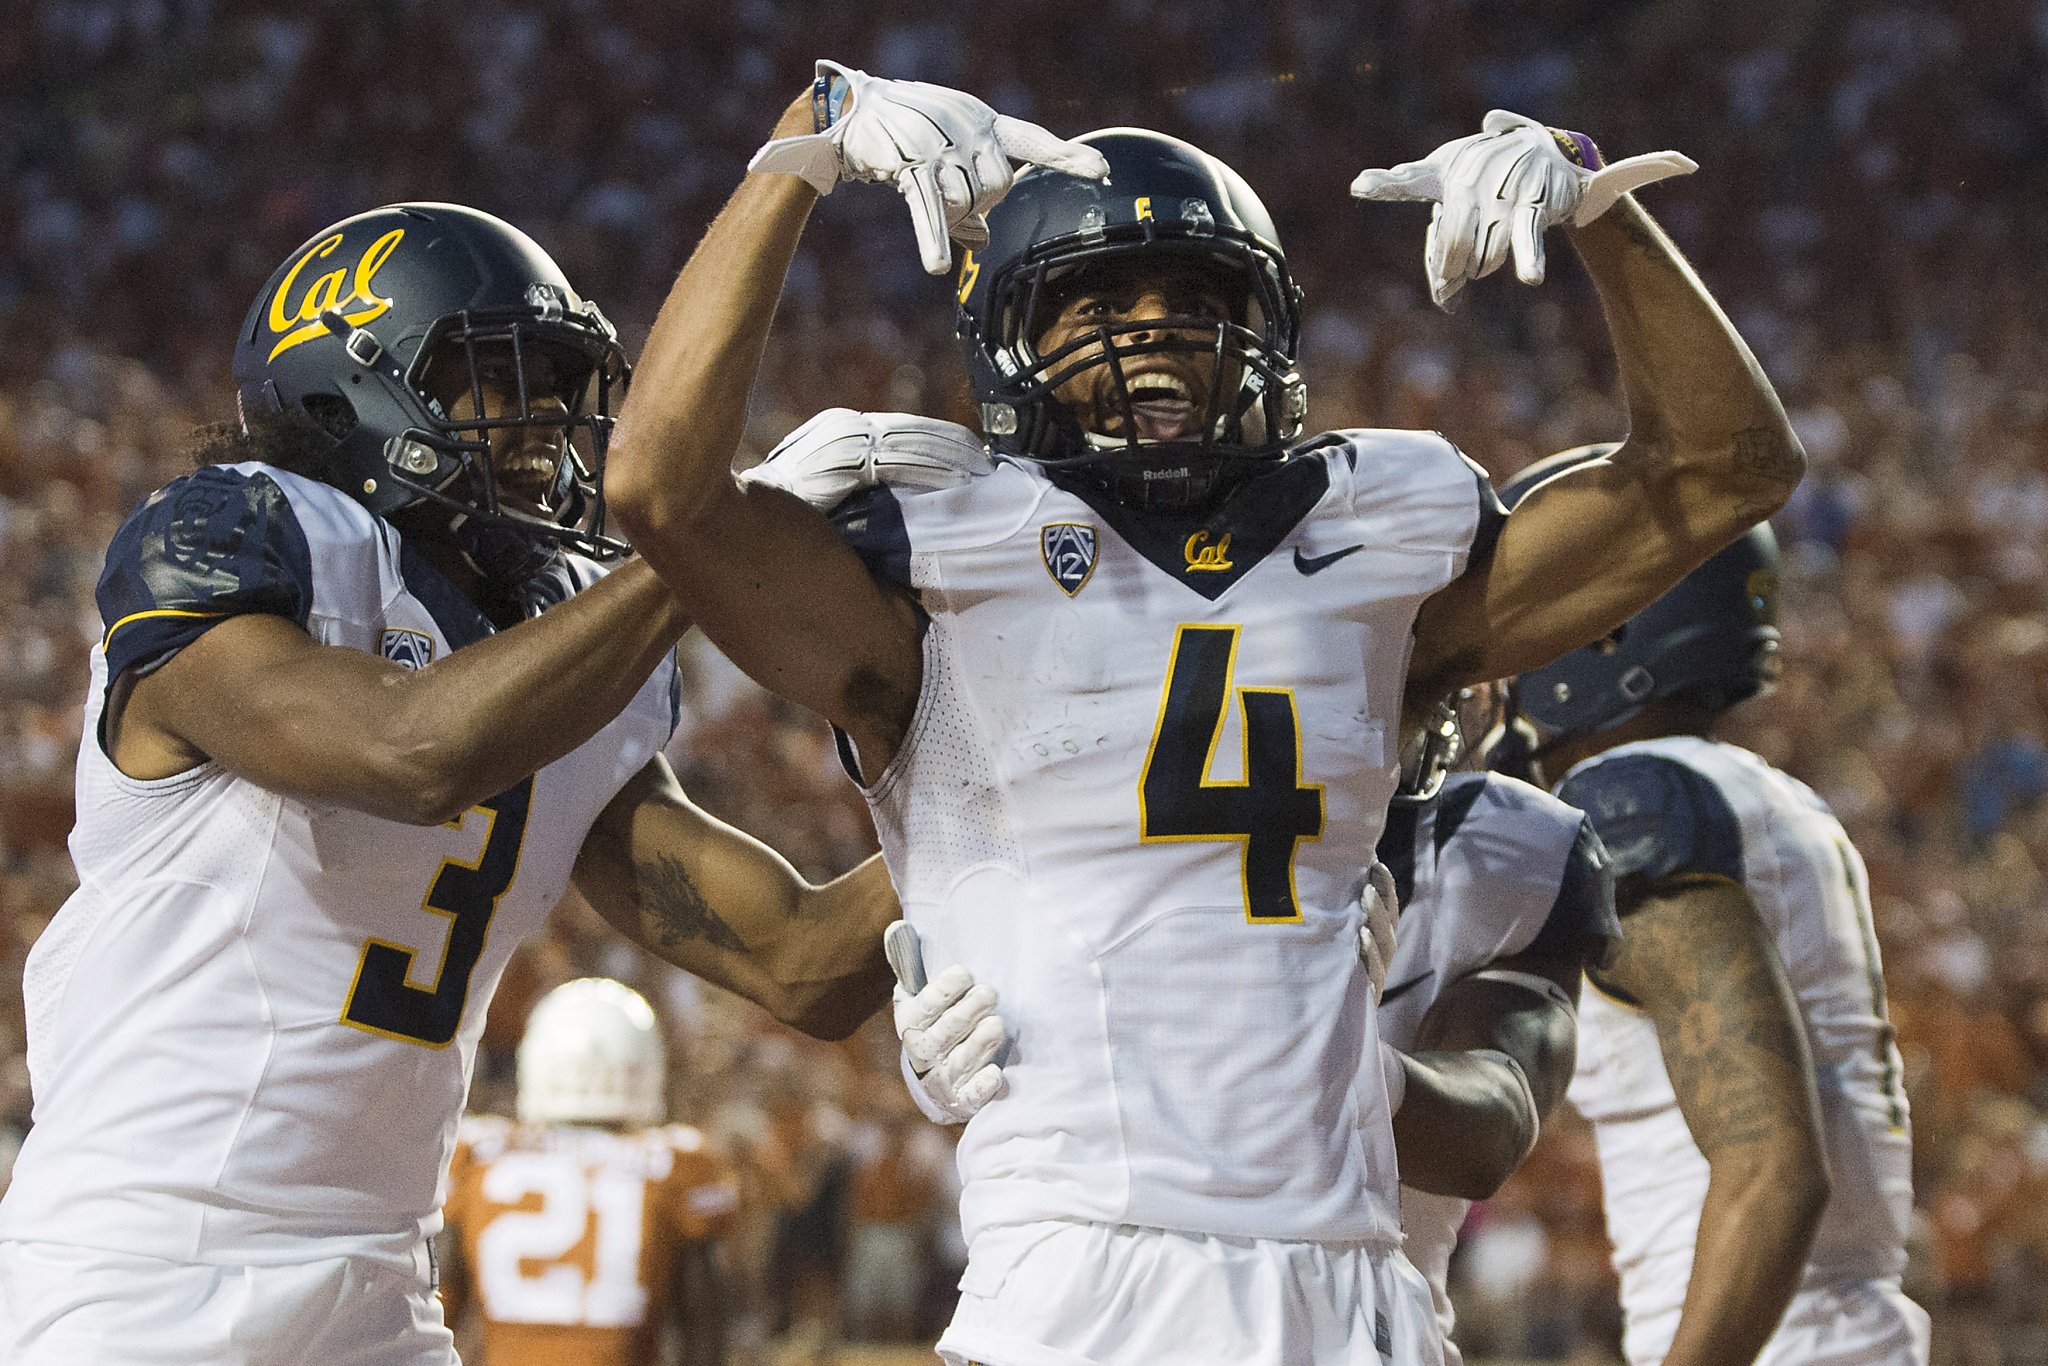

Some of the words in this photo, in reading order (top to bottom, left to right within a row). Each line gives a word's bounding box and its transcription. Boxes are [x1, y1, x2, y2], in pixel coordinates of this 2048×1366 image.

[267, 228, 405, 365] Cal
[1044, 525, 1096, 567] PAC
[1057, 552, 1084, 580] 12
[1184, 529, 1234, 574] Cal
[379, 631, 432, 670] PAC
[1137, 623, 1327, 924] 4
[339, 769, 537, 1050] 3
[477, 1150, 649, 1327] 21
